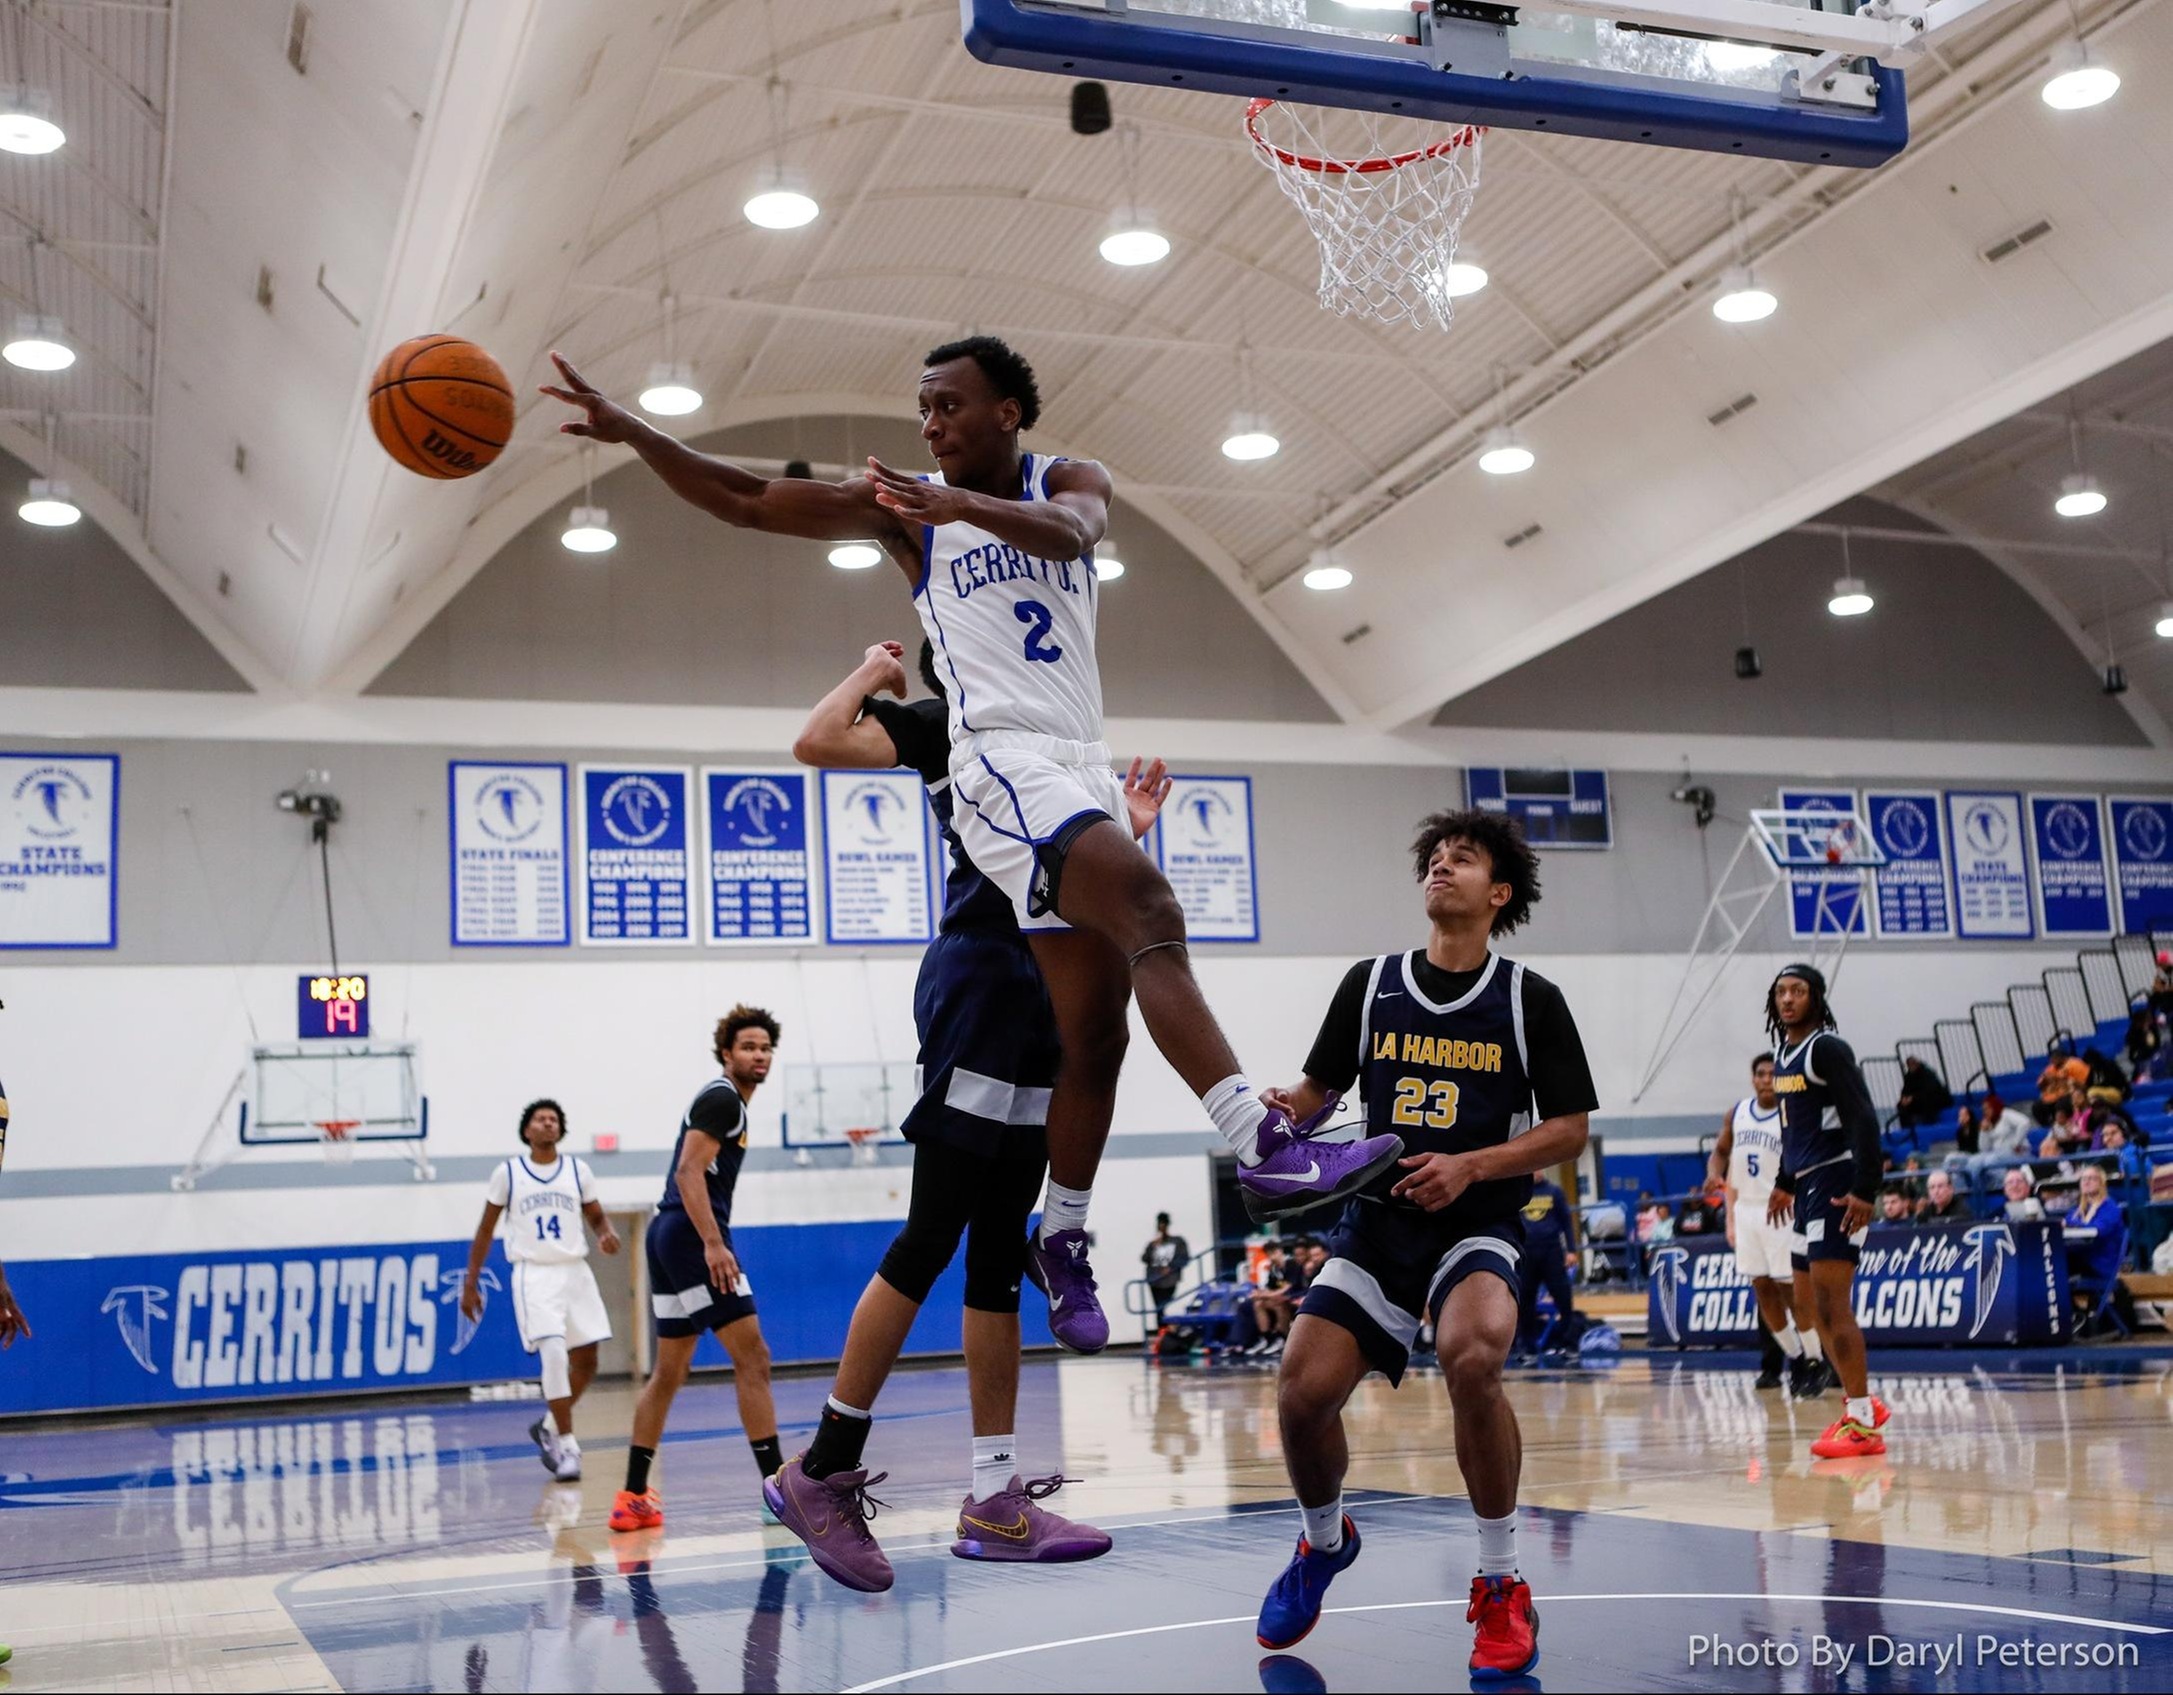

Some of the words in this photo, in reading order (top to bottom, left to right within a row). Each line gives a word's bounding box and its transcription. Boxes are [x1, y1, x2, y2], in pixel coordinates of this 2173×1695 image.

[1014, 600, 1062, 663] 2
[1570, 800, 1602, 813] GUEST
[21, 846, 81, 859] STATE
[461, 850, 505, 860] STATE
[0, 863, 105, 875] CHAMPIONS
[589, 865, 685, 880] CHAMPIONS
[713, 865, 806, 880] CHAMPIONS
[326, 1000, 356, 1032] 19
[1374, 1032, 1397, 1060] LA
[1402, 1033, 1502, 1072] HARBOR
[1392, 1076, 1460, 1129] 23
[1747, 1154, 1759, 1177] 5
[519, 1191, 574, 1214] CERRITOS
[535, 1215, 561, 1240] 14
[1888, 1235, 1921, 1277] of
[1919, 1233, 1962, 1275] the
[2041, 1227, 2060, 1336] FALCONS
[1851, 1277, 1965, 1329] LCONS
[172, 1254, 439, 1388] CERRITOS
